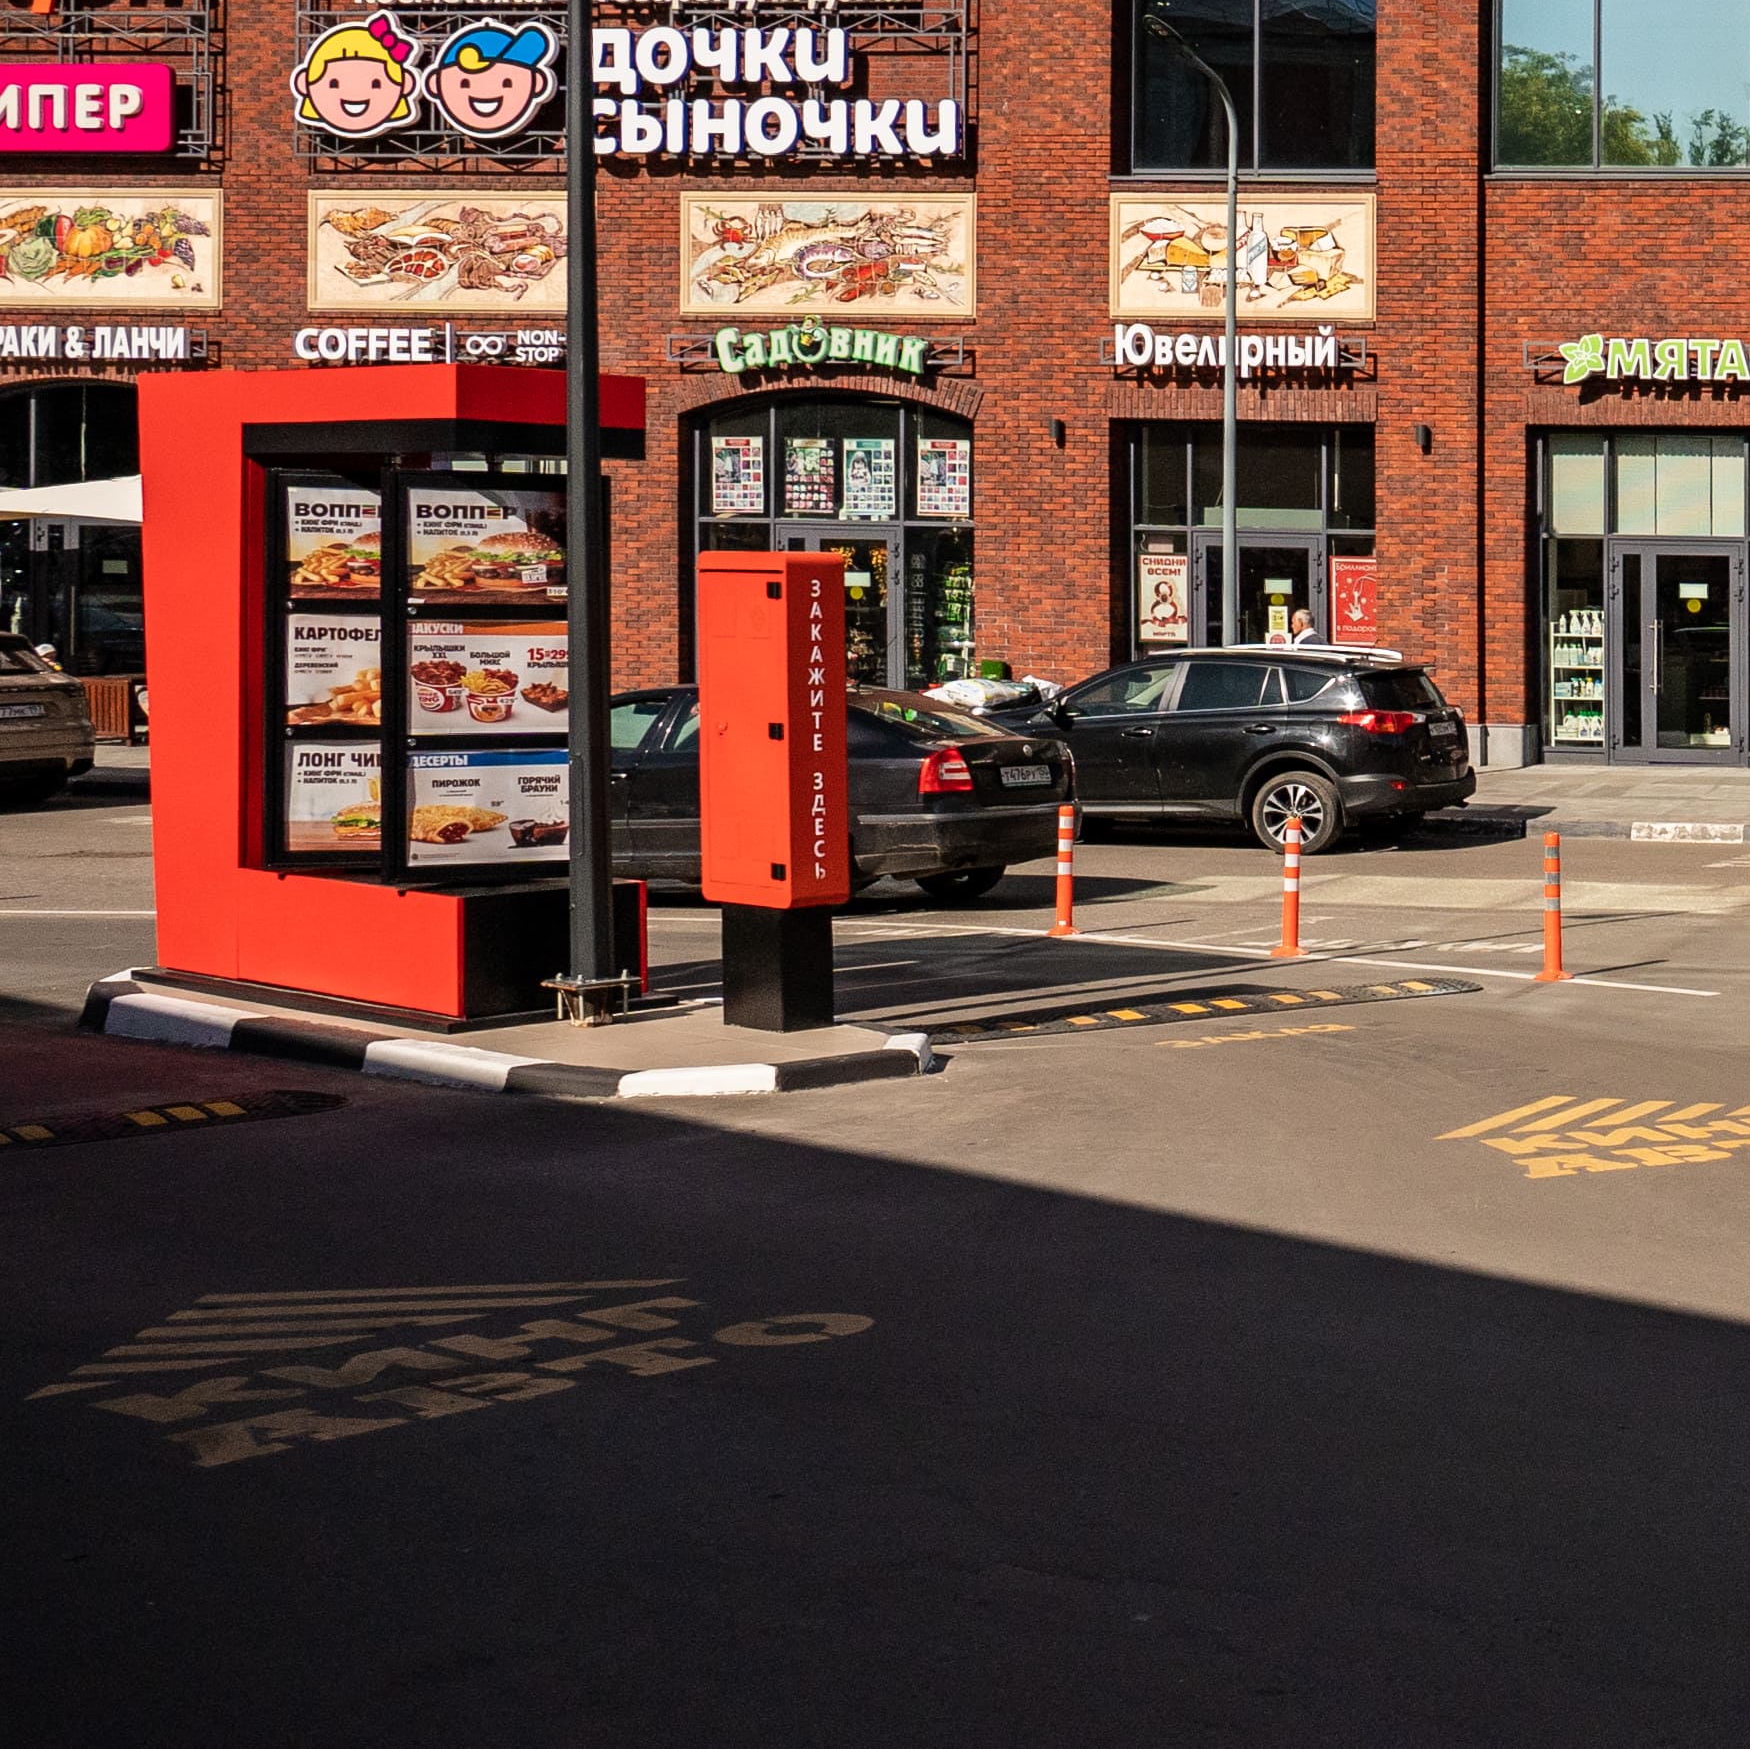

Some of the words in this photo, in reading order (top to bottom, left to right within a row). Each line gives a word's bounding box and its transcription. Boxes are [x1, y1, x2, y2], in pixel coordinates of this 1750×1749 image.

[590, 26, 851, 96] дочки
[65, 325, 85, 359] &
[92, 326, 186, 360] ЛАНЧИ
[296, 327, 432, 362] COFFEE
[515, 347, 559, 362] STOP
[807, 579, 826, 752] ЗАКАЖИТЕ
[297, 752, 346, 768] ЛОНГ
[412, 755, 469, 768] ДЕСЕРТЫ
[431, 777, 481, 789] ПИРОЖОК
[517, 774, 561, 785] ГОРЯЧИЙ
[520, 785, 558, 794] БРАУНИ
[811, 772, 827, 880] ЗДЕСЬ
[88, 1296, 703, 1424] КИНГ
[163, 1312, 876, 1469] АВТО
